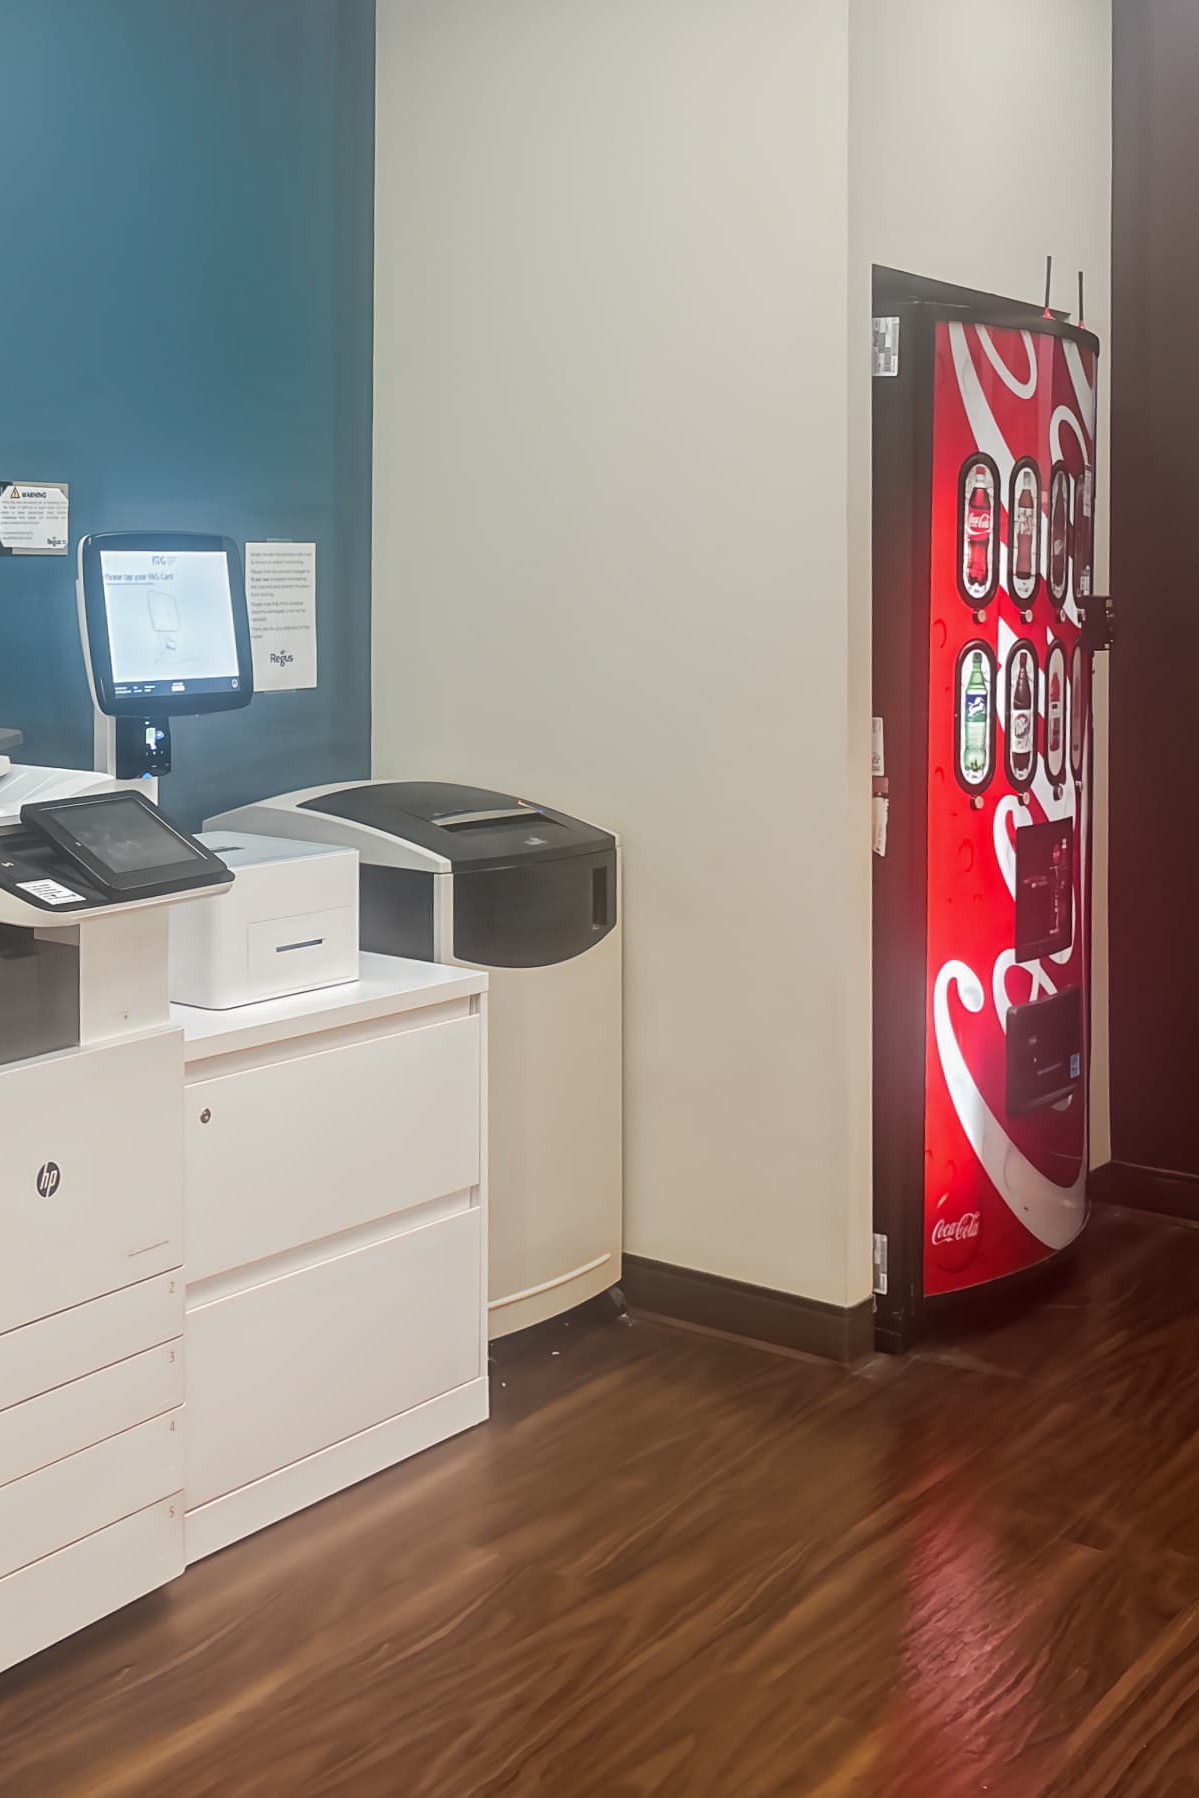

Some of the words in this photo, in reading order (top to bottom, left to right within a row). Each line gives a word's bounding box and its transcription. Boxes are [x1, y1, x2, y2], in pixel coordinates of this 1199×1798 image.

[270, 649, 294, 668] Regus
[37, 1161, 60, 1199] hp
[931, 1211, 981, 1246] Coca-Cola
